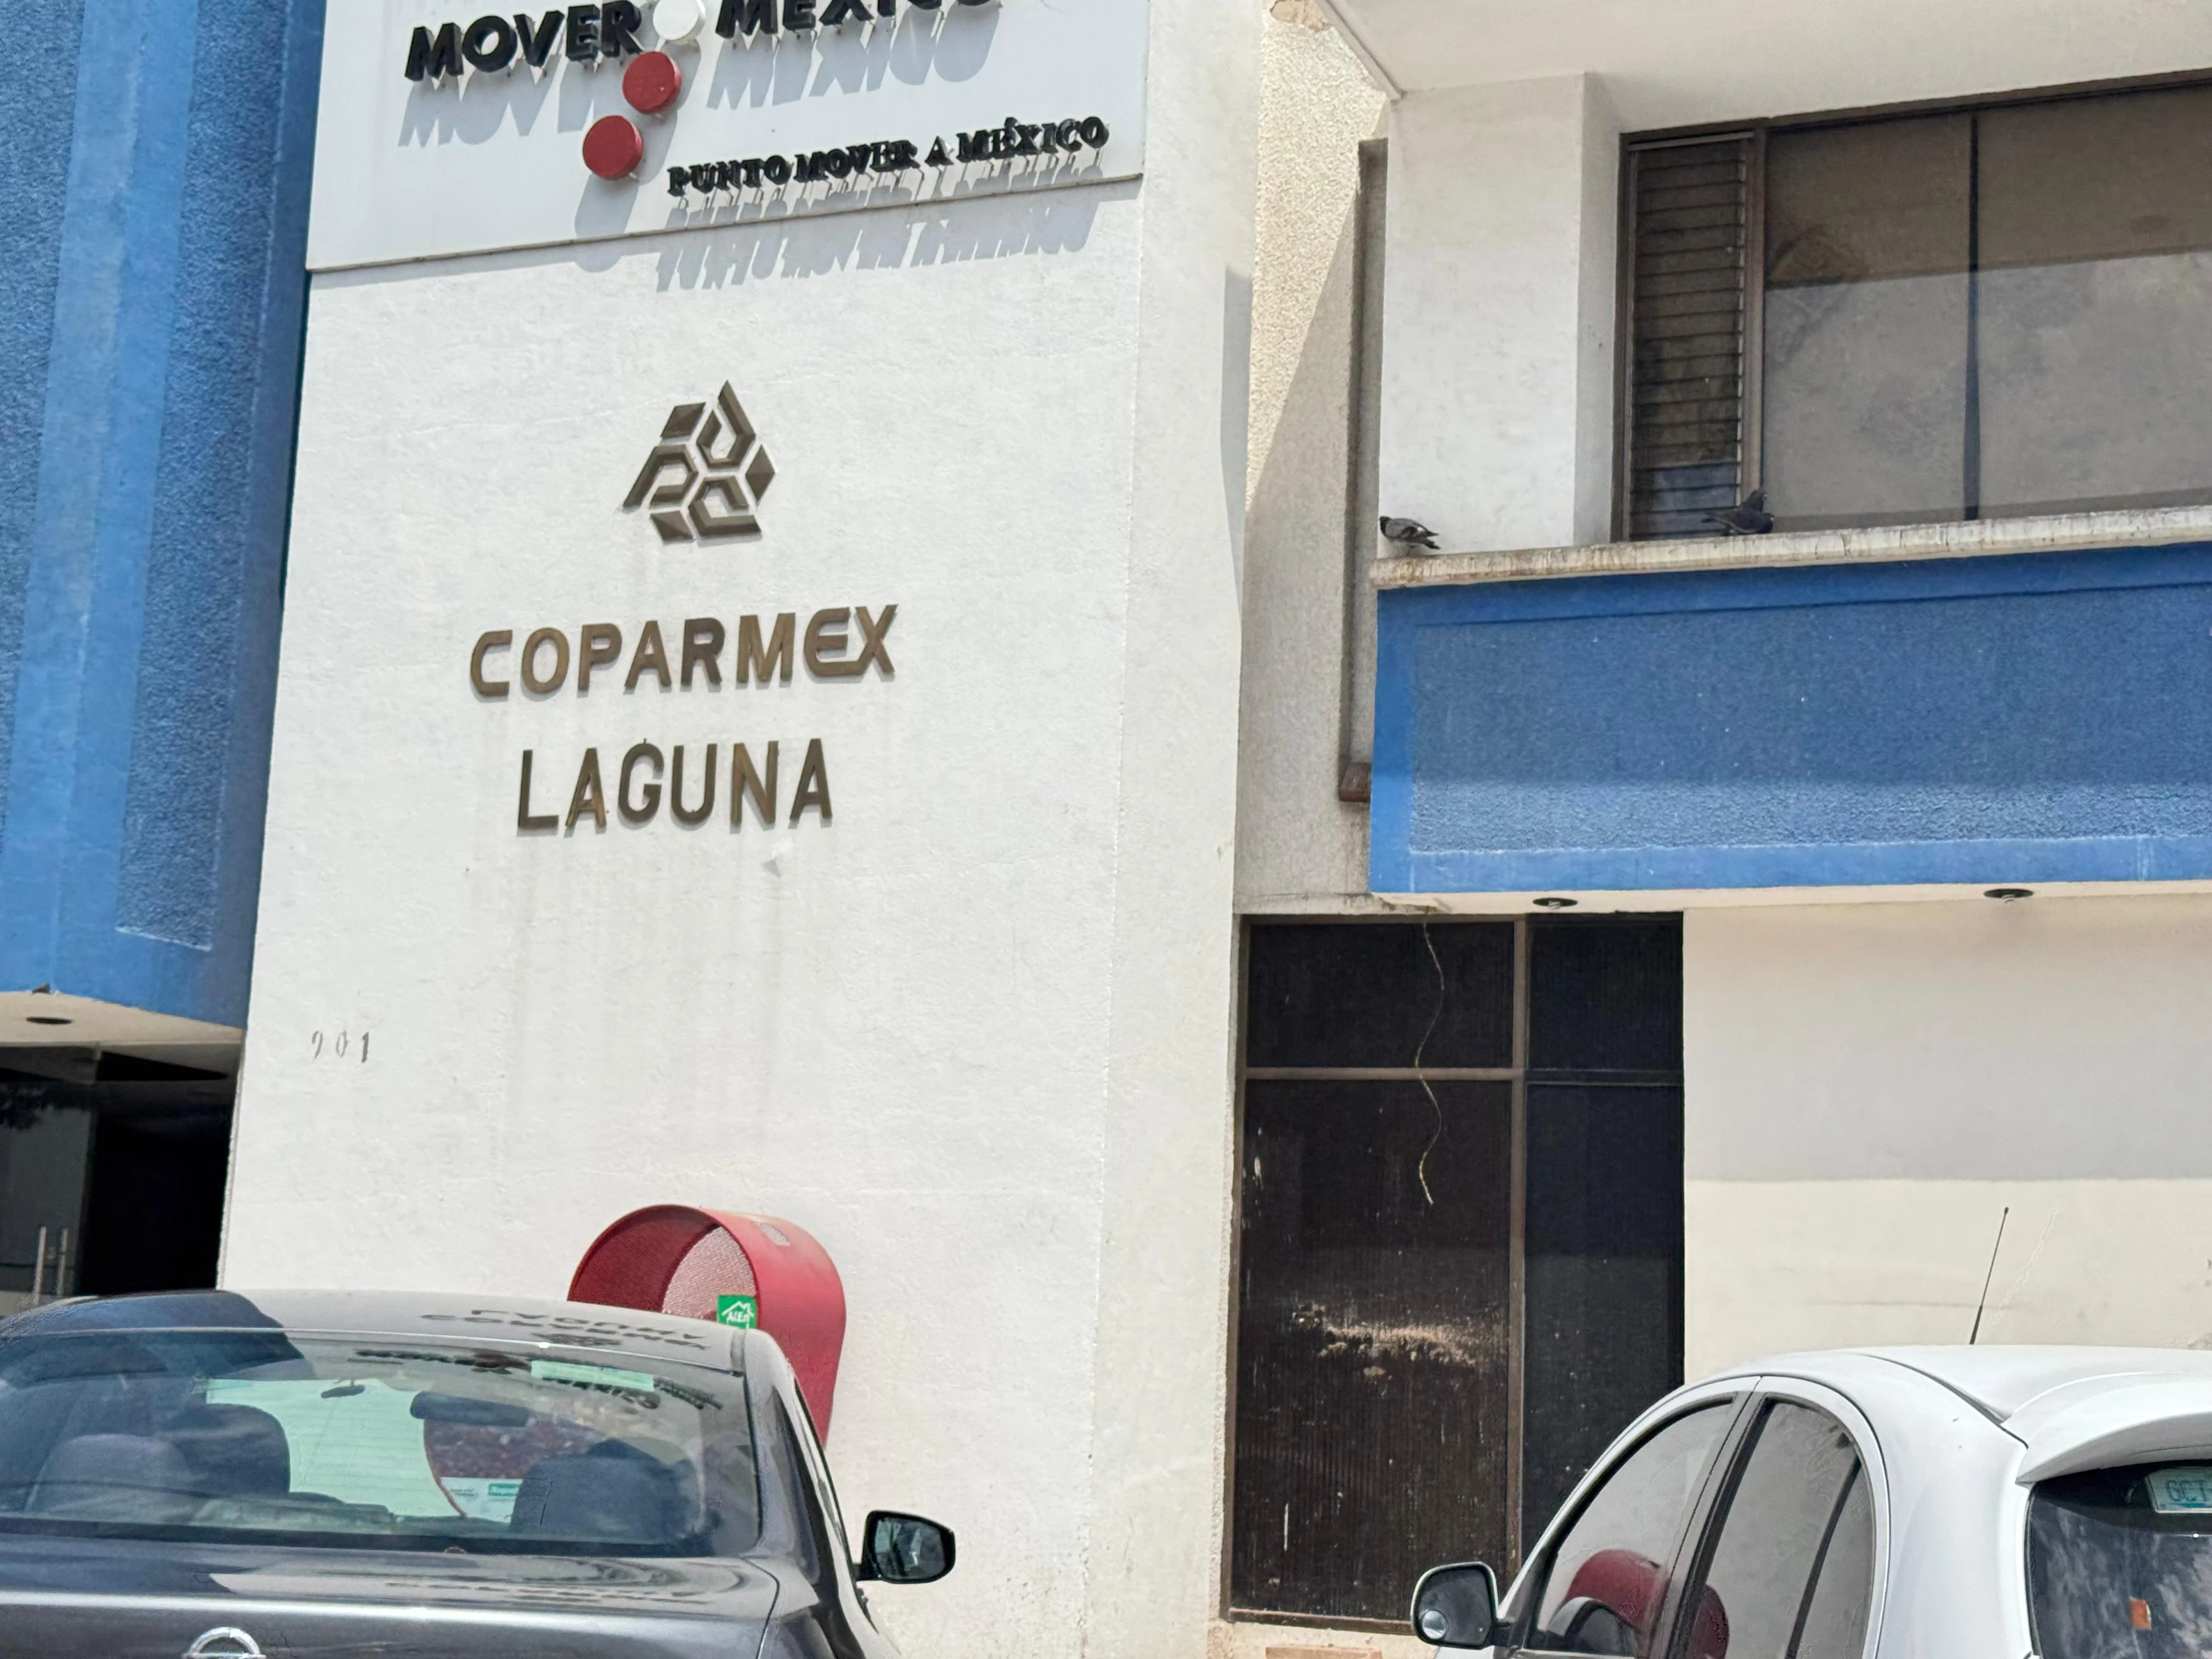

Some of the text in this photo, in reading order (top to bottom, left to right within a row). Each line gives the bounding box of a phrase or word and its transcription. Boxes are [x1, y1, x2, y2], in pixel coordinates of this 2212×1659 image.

[405, 0, 645, 81] MOVER
[668, 116, 1109, 196] PUNTO MOVER A MÉXICO
[470, 604, 899, 696] COPARMEX
[518, 738, 832, 828] LAGUNA
[311, 1029, 369, 1063] 901
